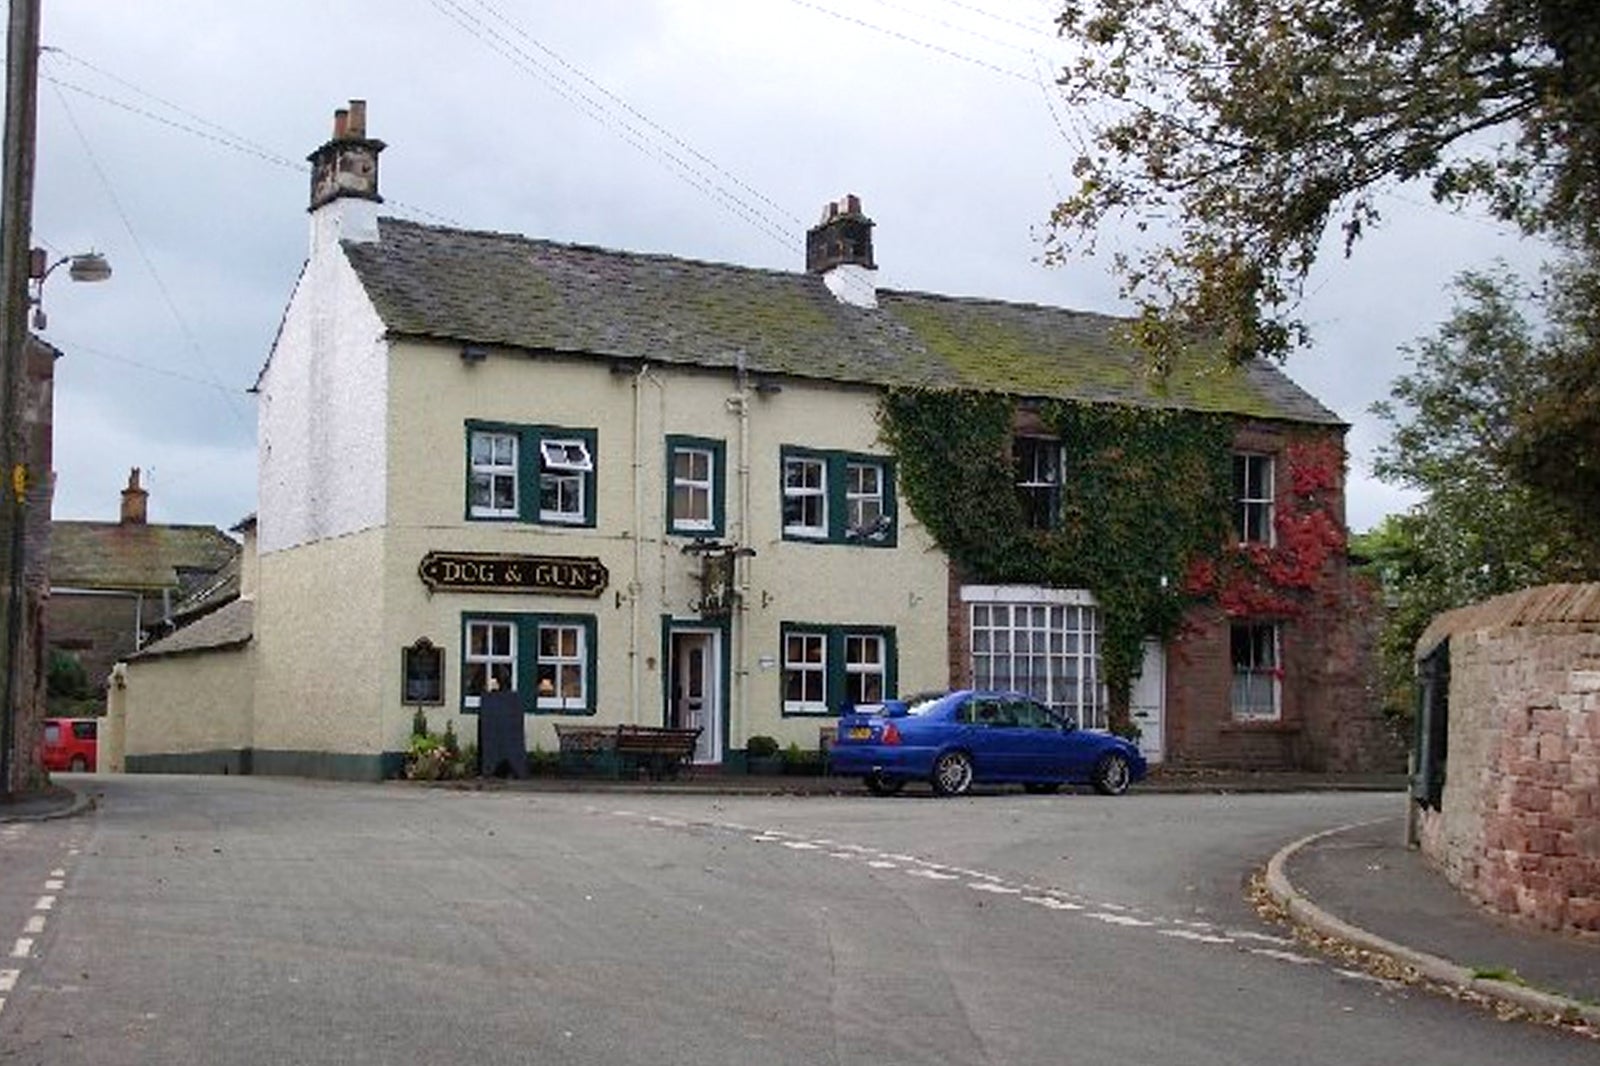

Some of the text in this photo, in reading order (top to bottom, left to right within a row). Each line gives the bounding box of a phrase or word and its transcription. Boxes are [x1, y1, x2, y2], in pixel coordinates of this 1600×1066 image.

[443, 562, 587, 586] DOG & GUN
